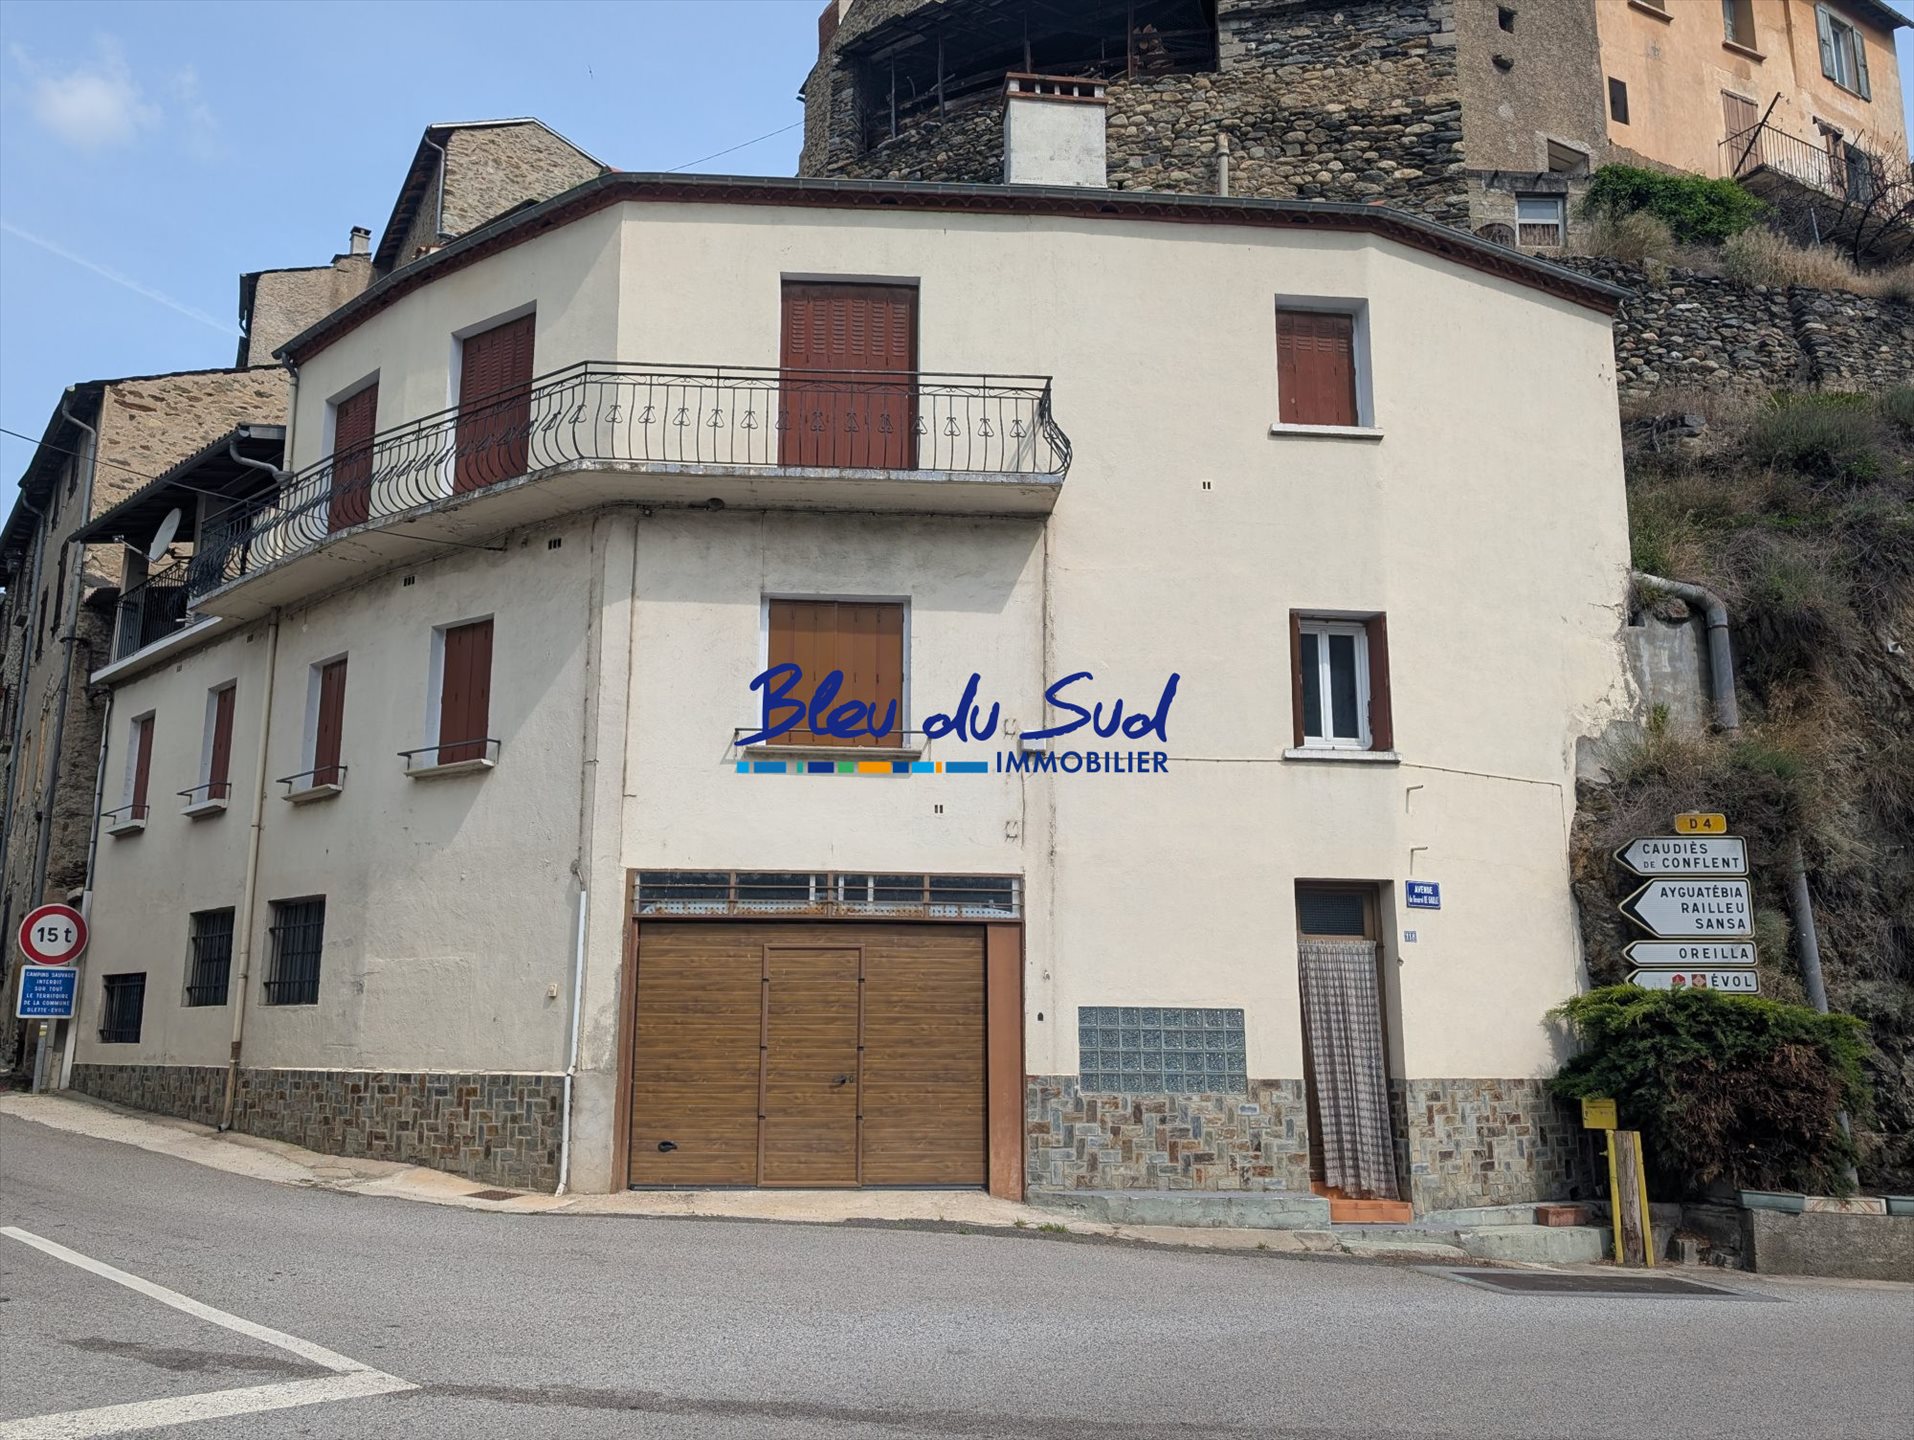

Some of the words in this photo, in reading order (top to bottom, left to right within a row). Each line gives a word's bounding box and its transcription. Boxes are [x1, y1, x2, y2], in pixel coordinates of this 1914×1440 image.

[1689, 818, 1698, 828] D
[1703, 818, 1712, 828] 4
[1642, 841, 1708, 854] CAUDIÈS
[1643, 861, 1656, 869] DE
[1662, 857, 1739, 868] CONFLENT
[1660, 885, 1742, 898] AYGUATÉBIA
[1681, 903, 1744, 913] RAILLEU
[1695, 918, 1746, 929] SANSA
[37, 927, 58, 942] 15
[1679, 948, 1749, 959] OREILLA
[1711, 973, 1752, 987] ÉVOL
